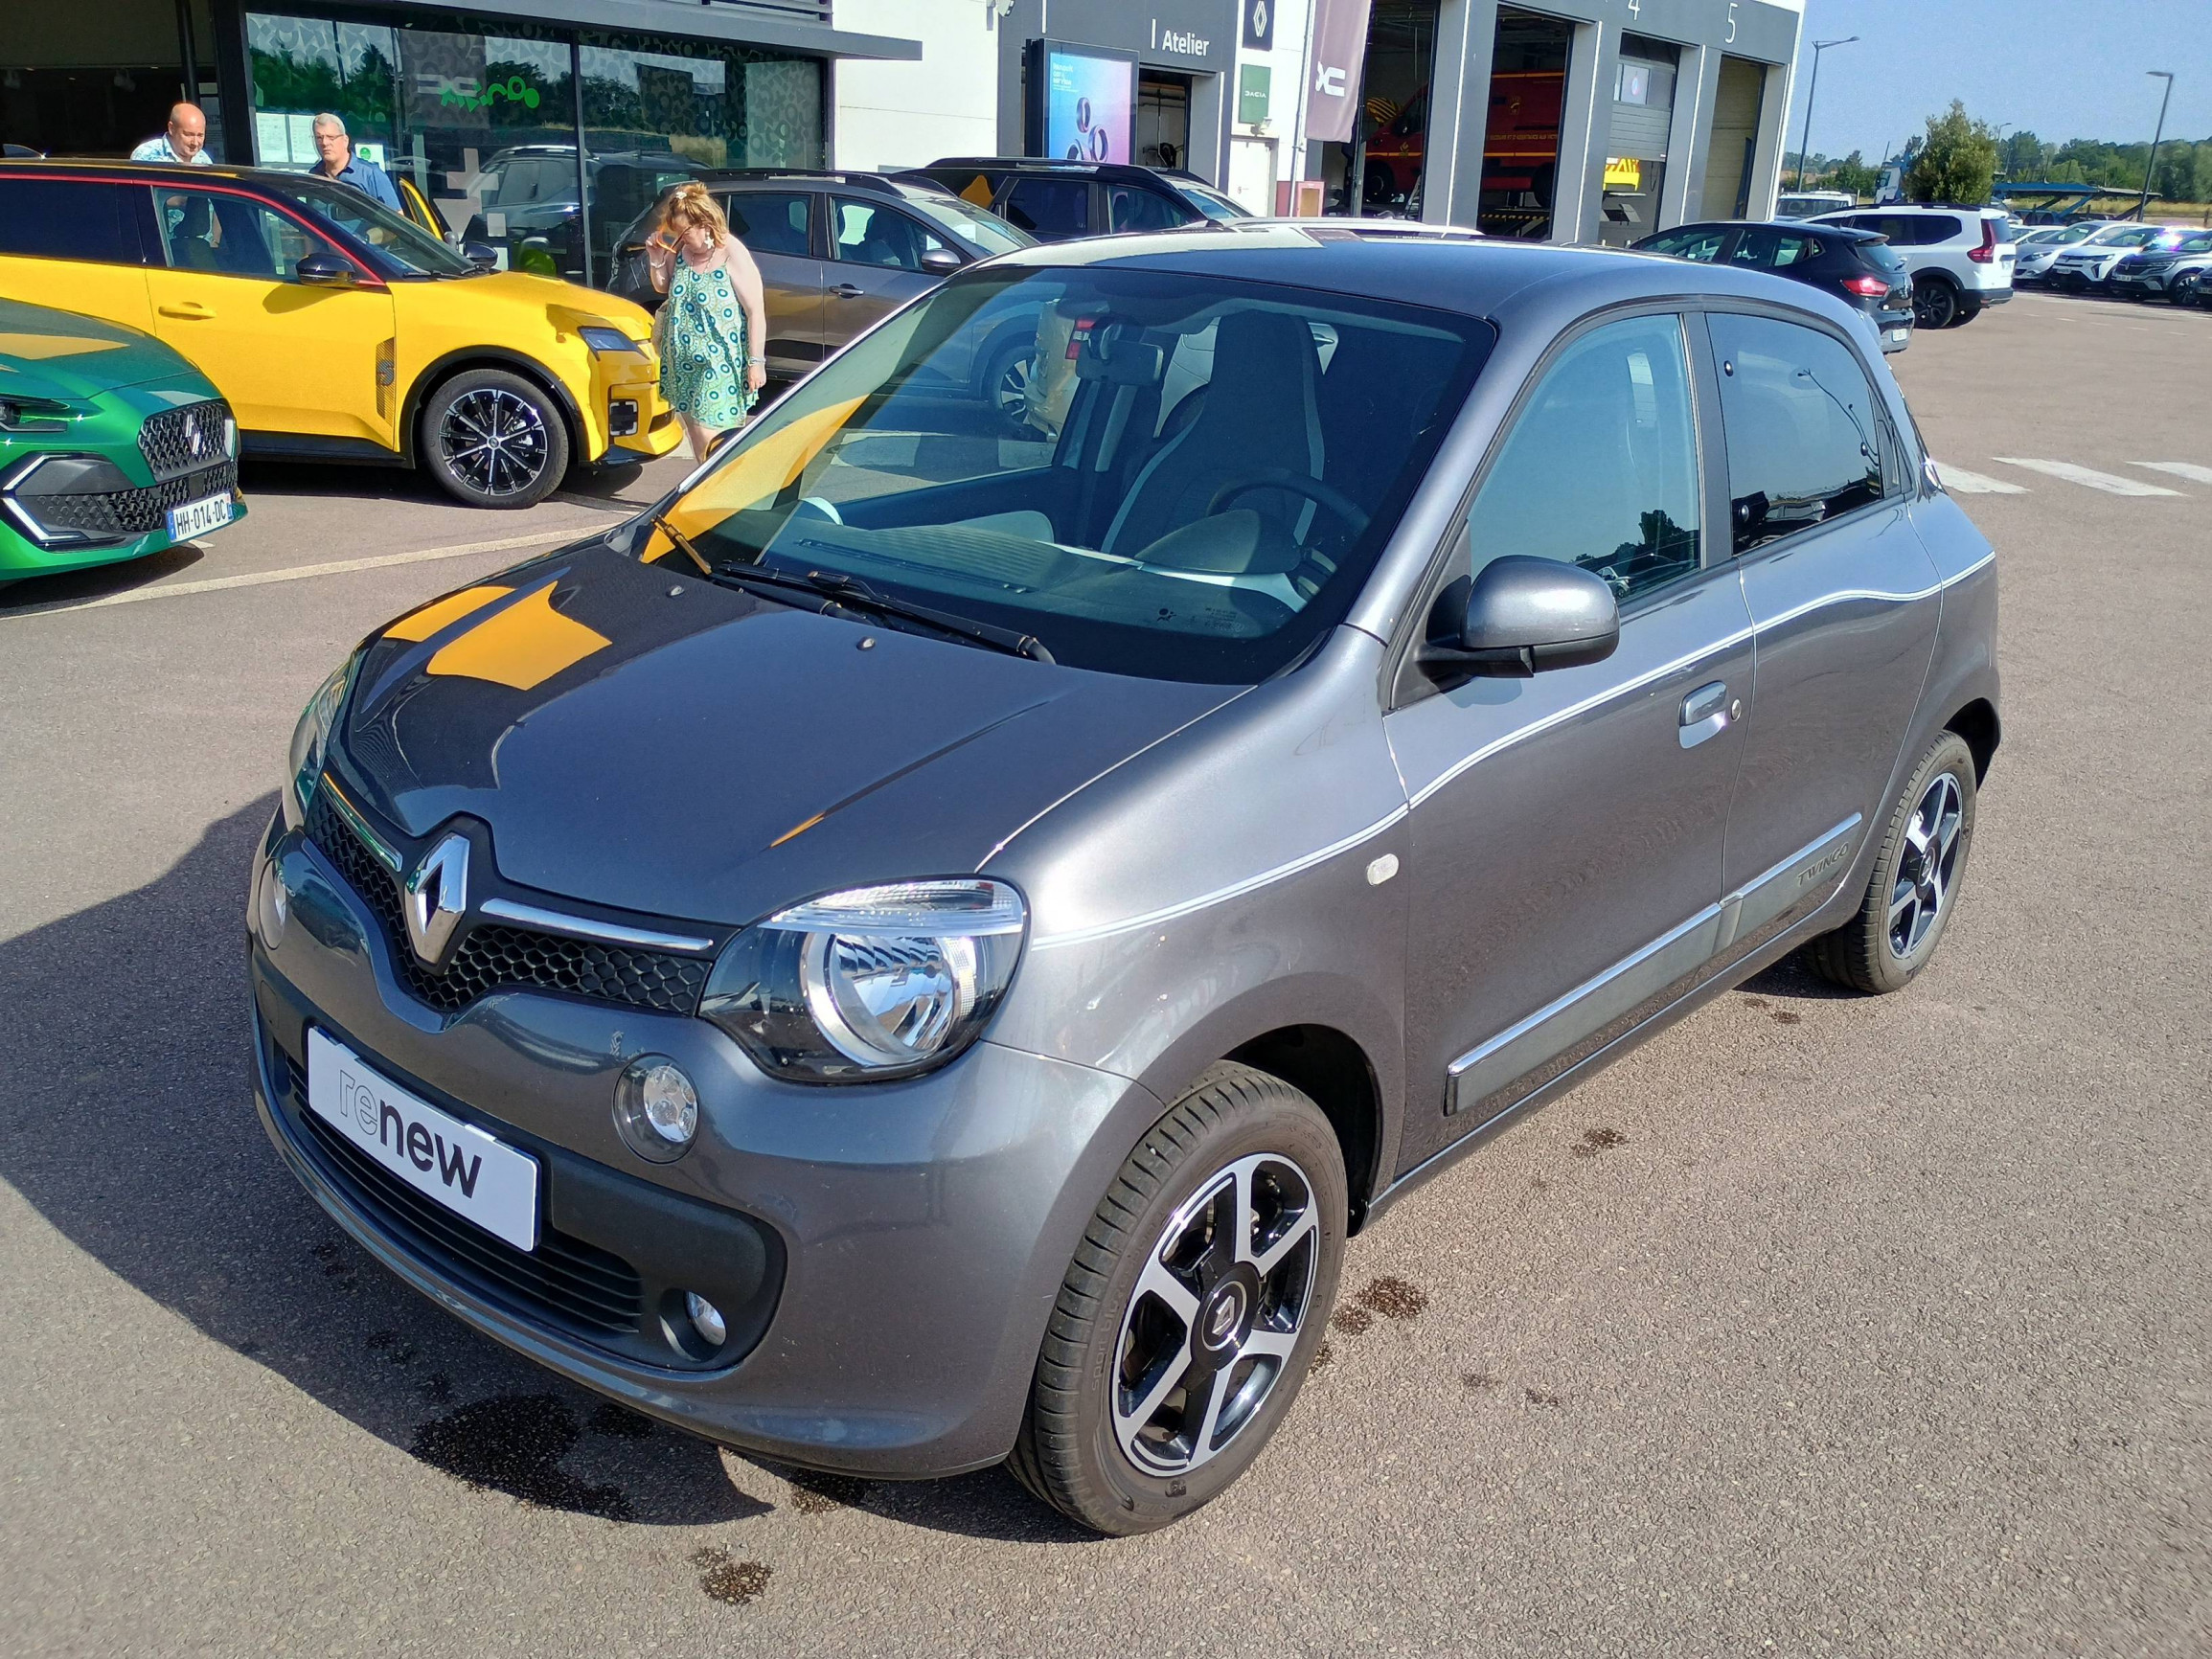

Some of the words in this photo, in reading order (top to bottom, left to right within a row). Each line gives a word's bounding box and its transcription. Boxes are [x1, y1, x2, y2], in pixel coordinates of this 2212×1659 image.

[1724, 2, 1738, 43] 5
[1162, 30, 1210, 57] Atelier
[1244, 90, 1266, 99] DACIA
[175, 498, 227, 536] HH-014-DC
[1798, 841, 1849, 886] TWINGO
[339, 1069, 482, 1199] renew
